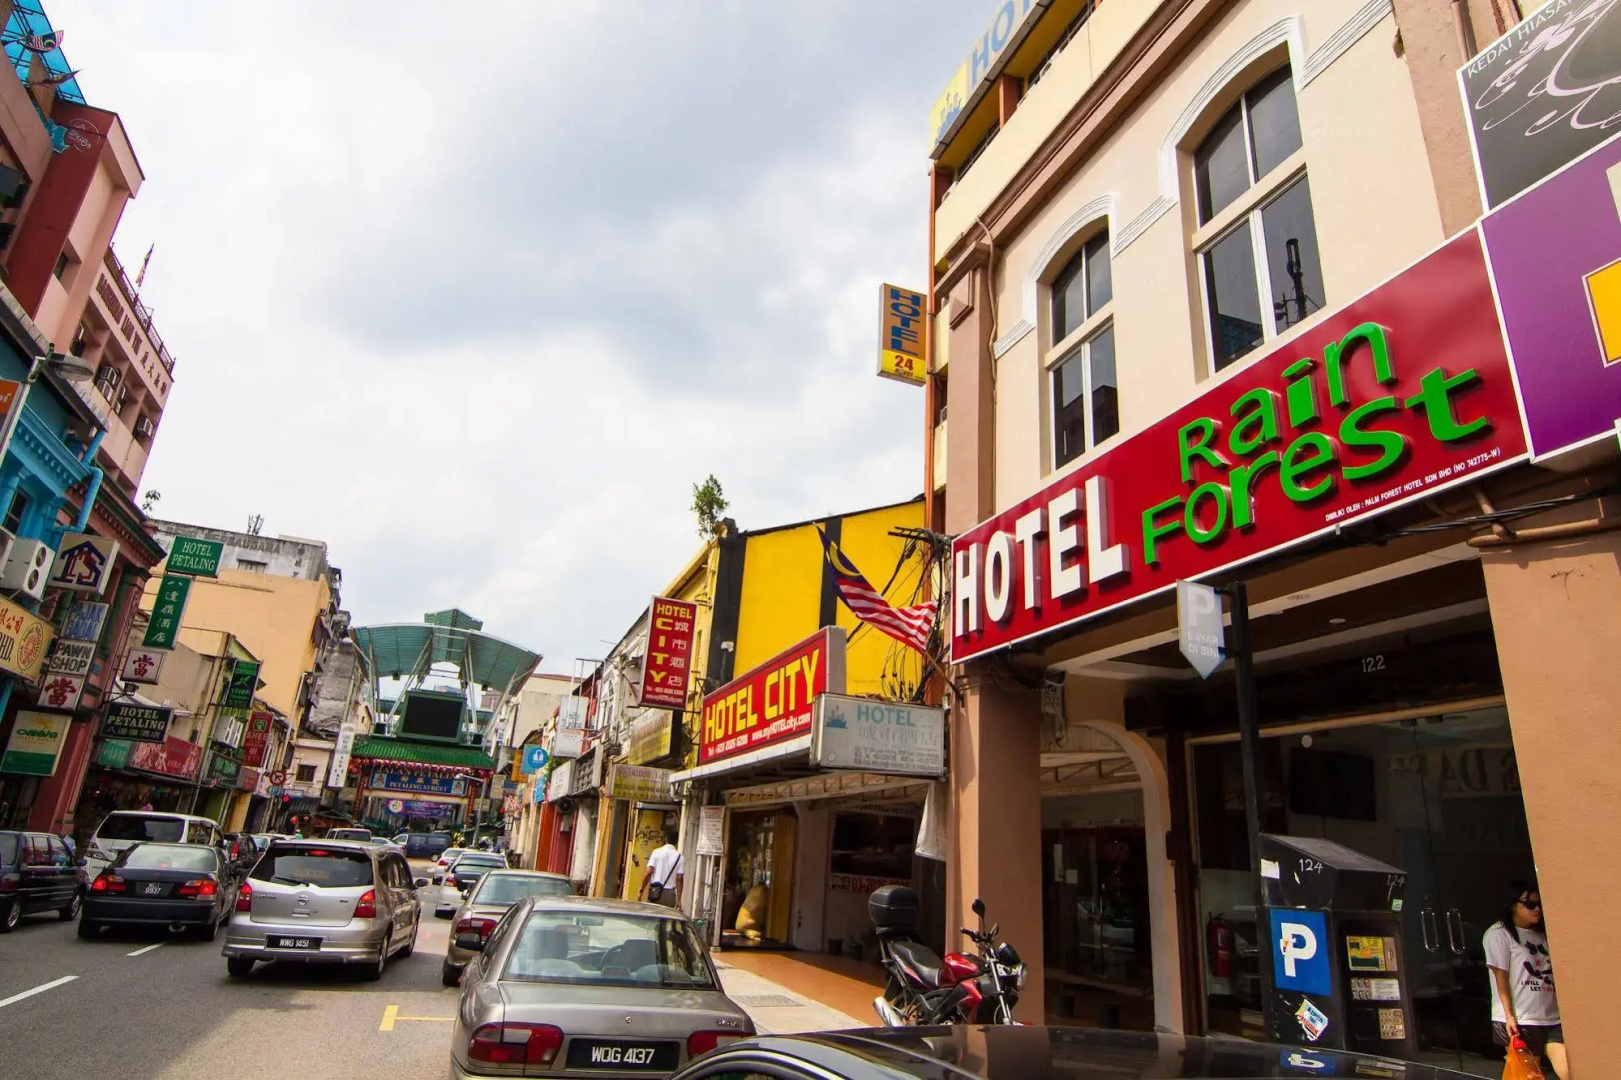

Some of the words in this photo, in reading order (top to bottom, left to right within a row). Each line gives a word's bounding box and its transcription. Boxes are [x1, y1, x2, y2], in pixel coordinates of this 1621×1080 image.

[1467, 36, 1513, 79] KEDAI
[890, 287, 920, 356] HOTEL
[894, 355, 914, 371] 24
[1177, 321, 1398, 484] Rain
[1141, 366, 1494, 566] Forest
[1364, 496, 1380, 507] PALM
[1380, 487, 1402, 501] FOREST
[1404, 480, 1423, 491] HOTEL
[1424, 473, 1438, 483] SDN
[1438, 467, 1452, 478] BHD
[1453, 461, 1466, 474] (NO
[181, 541, 212, 556] HOTEL
[954, 475, 1130, 638] HOTEL
[171, 554, 216, 571] PETALING
[656, 604, 692, 619] HOTEL
[1187, 587, 1216, 627] P
[1187, 630, 1219, 646] BAYAR
[56, 643, 92, 660] PAWN
[649, 617, 674, 683] CITY
[1188, 643, 1199, 655] DI
[1200, 646, 1219, 658] SINI
[50, 656, 87, 673] SHOP
[1362, 655, 1385, 673] 122
[704, 684, 758, 744] HOTEL
[764, 648, 820, 720] CITY
[120, 706, 159, 720] HOTEL
[857, 705, 916, 727] HOTEL
[106, 715, 166, 730] PETALING
[414, 766, 462, 779] PETALIN
[389, 781, 422, 790] PETALING
[423, 784, 448, 792] STREET
[1299, 858, 1324, 875] 124
[1385, 874, 1406, 892] 124
[279, 939, 294, 947] WWG
[295, 940, 309, 948] 1451
[1280, 922, 1317, 978] P
[624, 1048, 655, 1064] 4137
